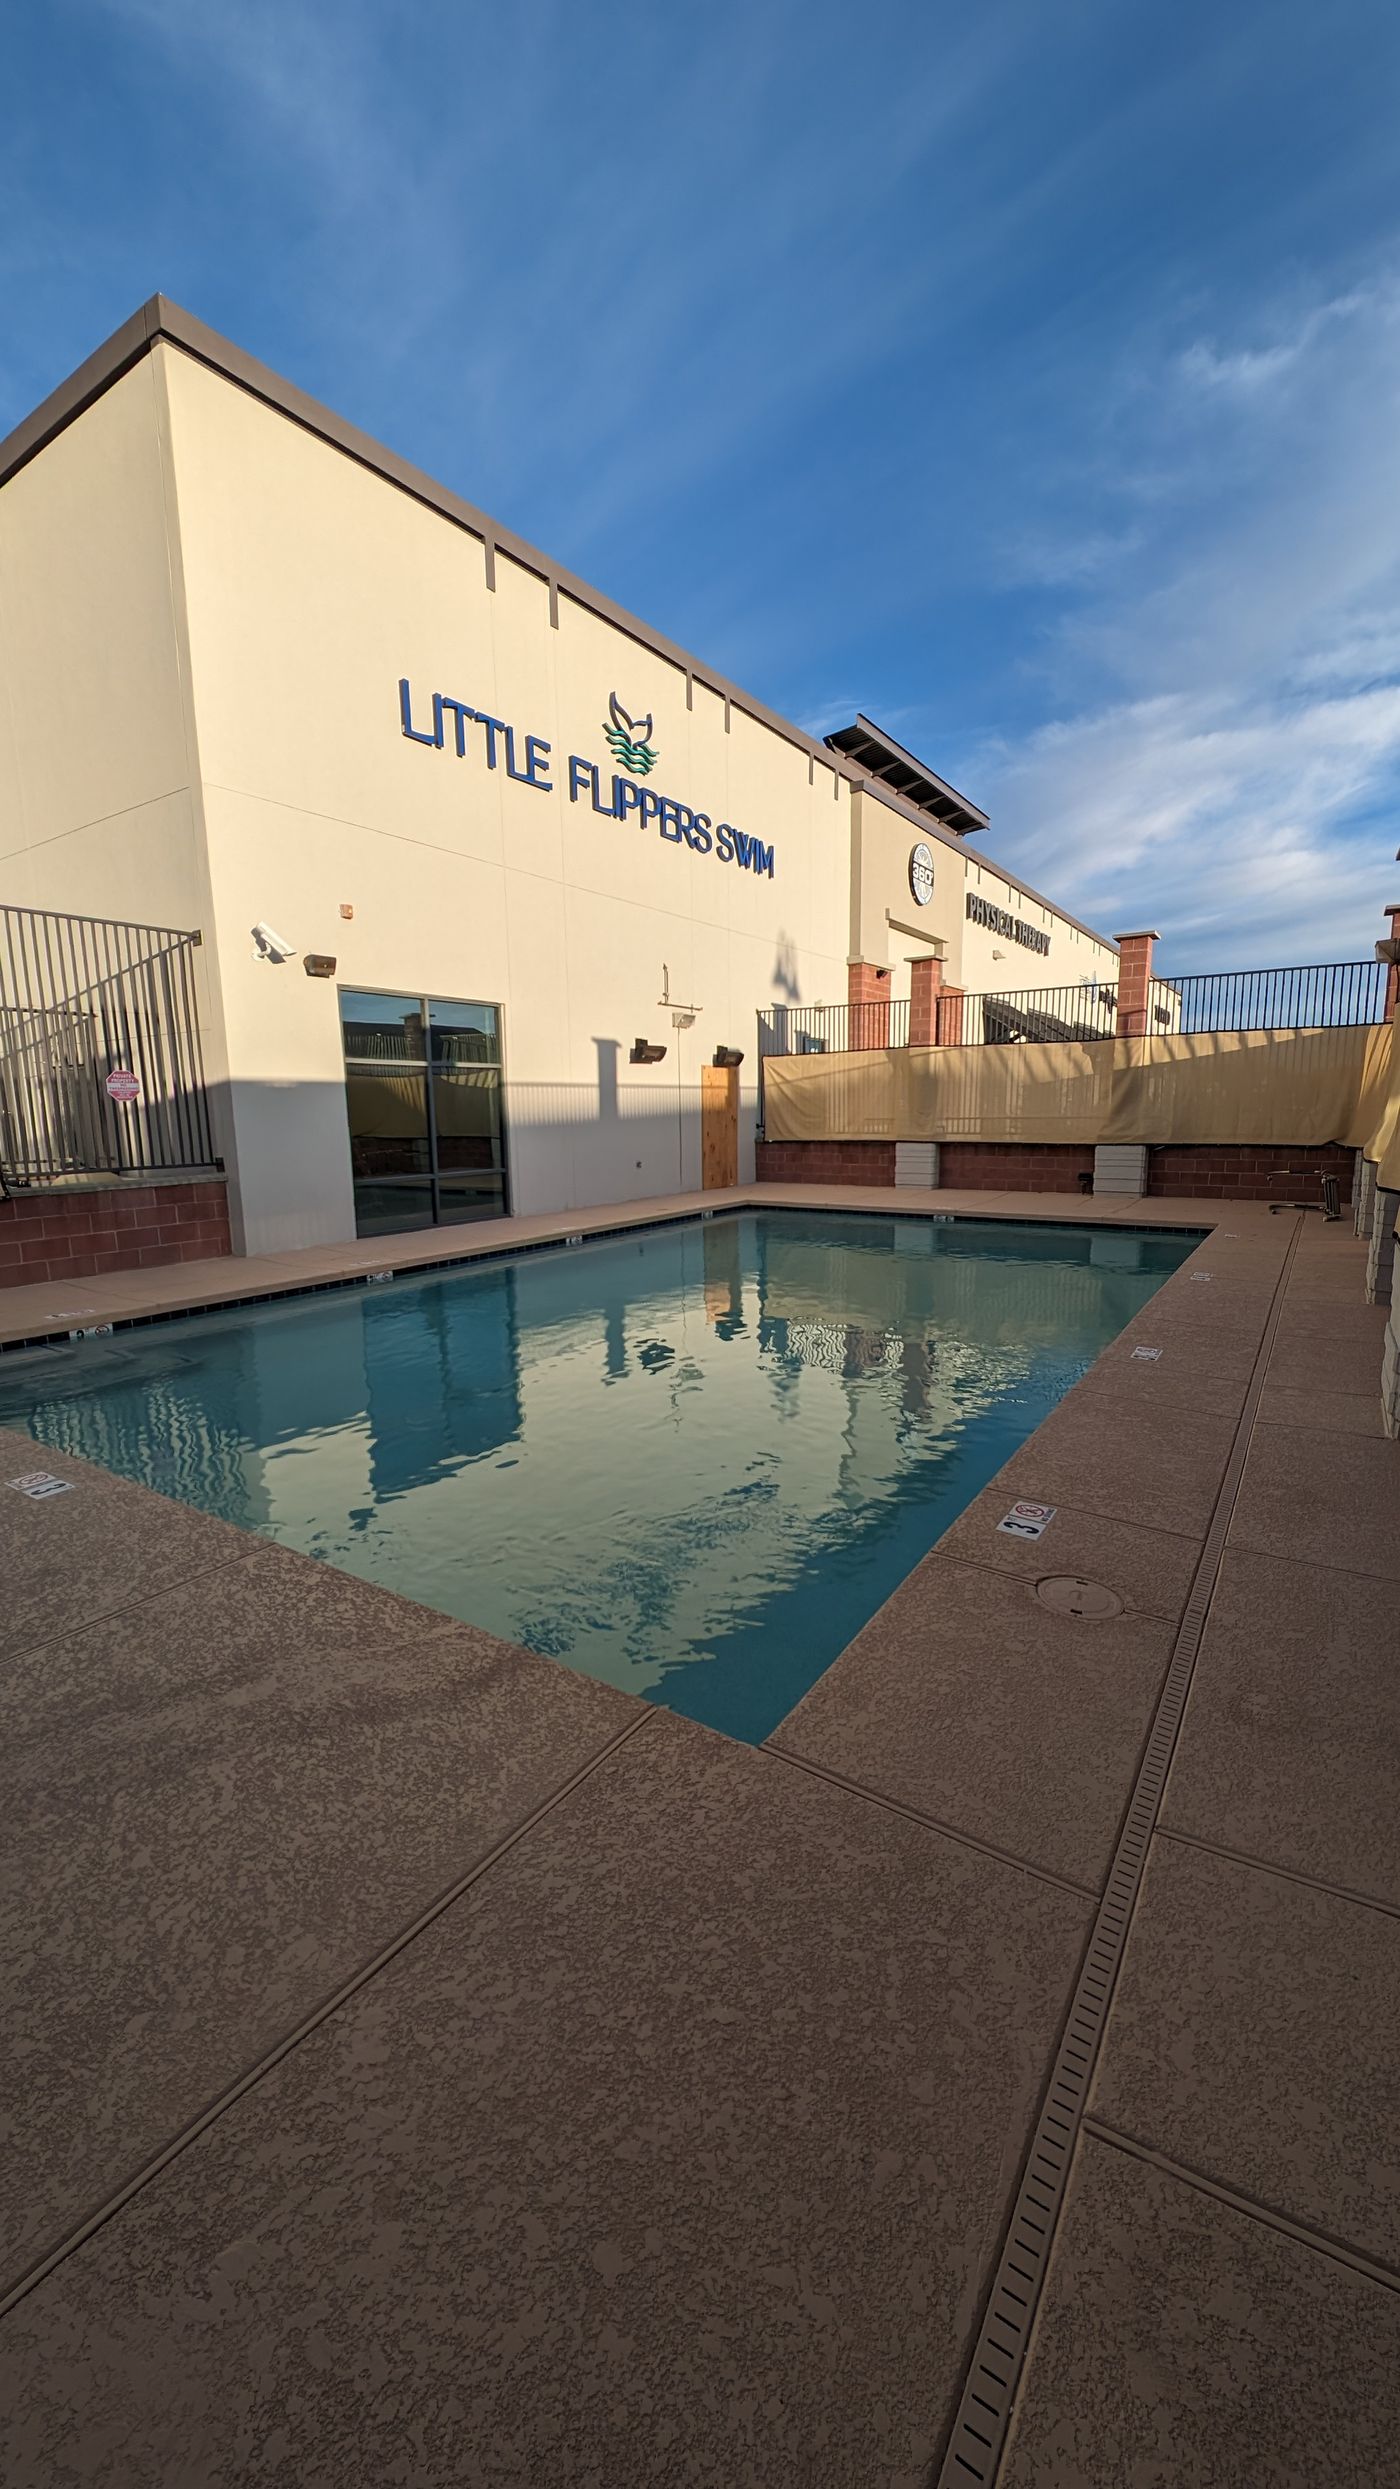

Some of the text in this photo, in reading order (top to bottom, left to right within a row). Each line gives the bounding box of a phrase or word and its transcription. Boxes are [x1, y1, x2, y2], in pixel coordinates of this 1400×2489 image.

[398, 678, 775, 879] LITTLE FLIPPERS SWIM
[966, 892, 1051, 957] PHYSICAL THERAPY
